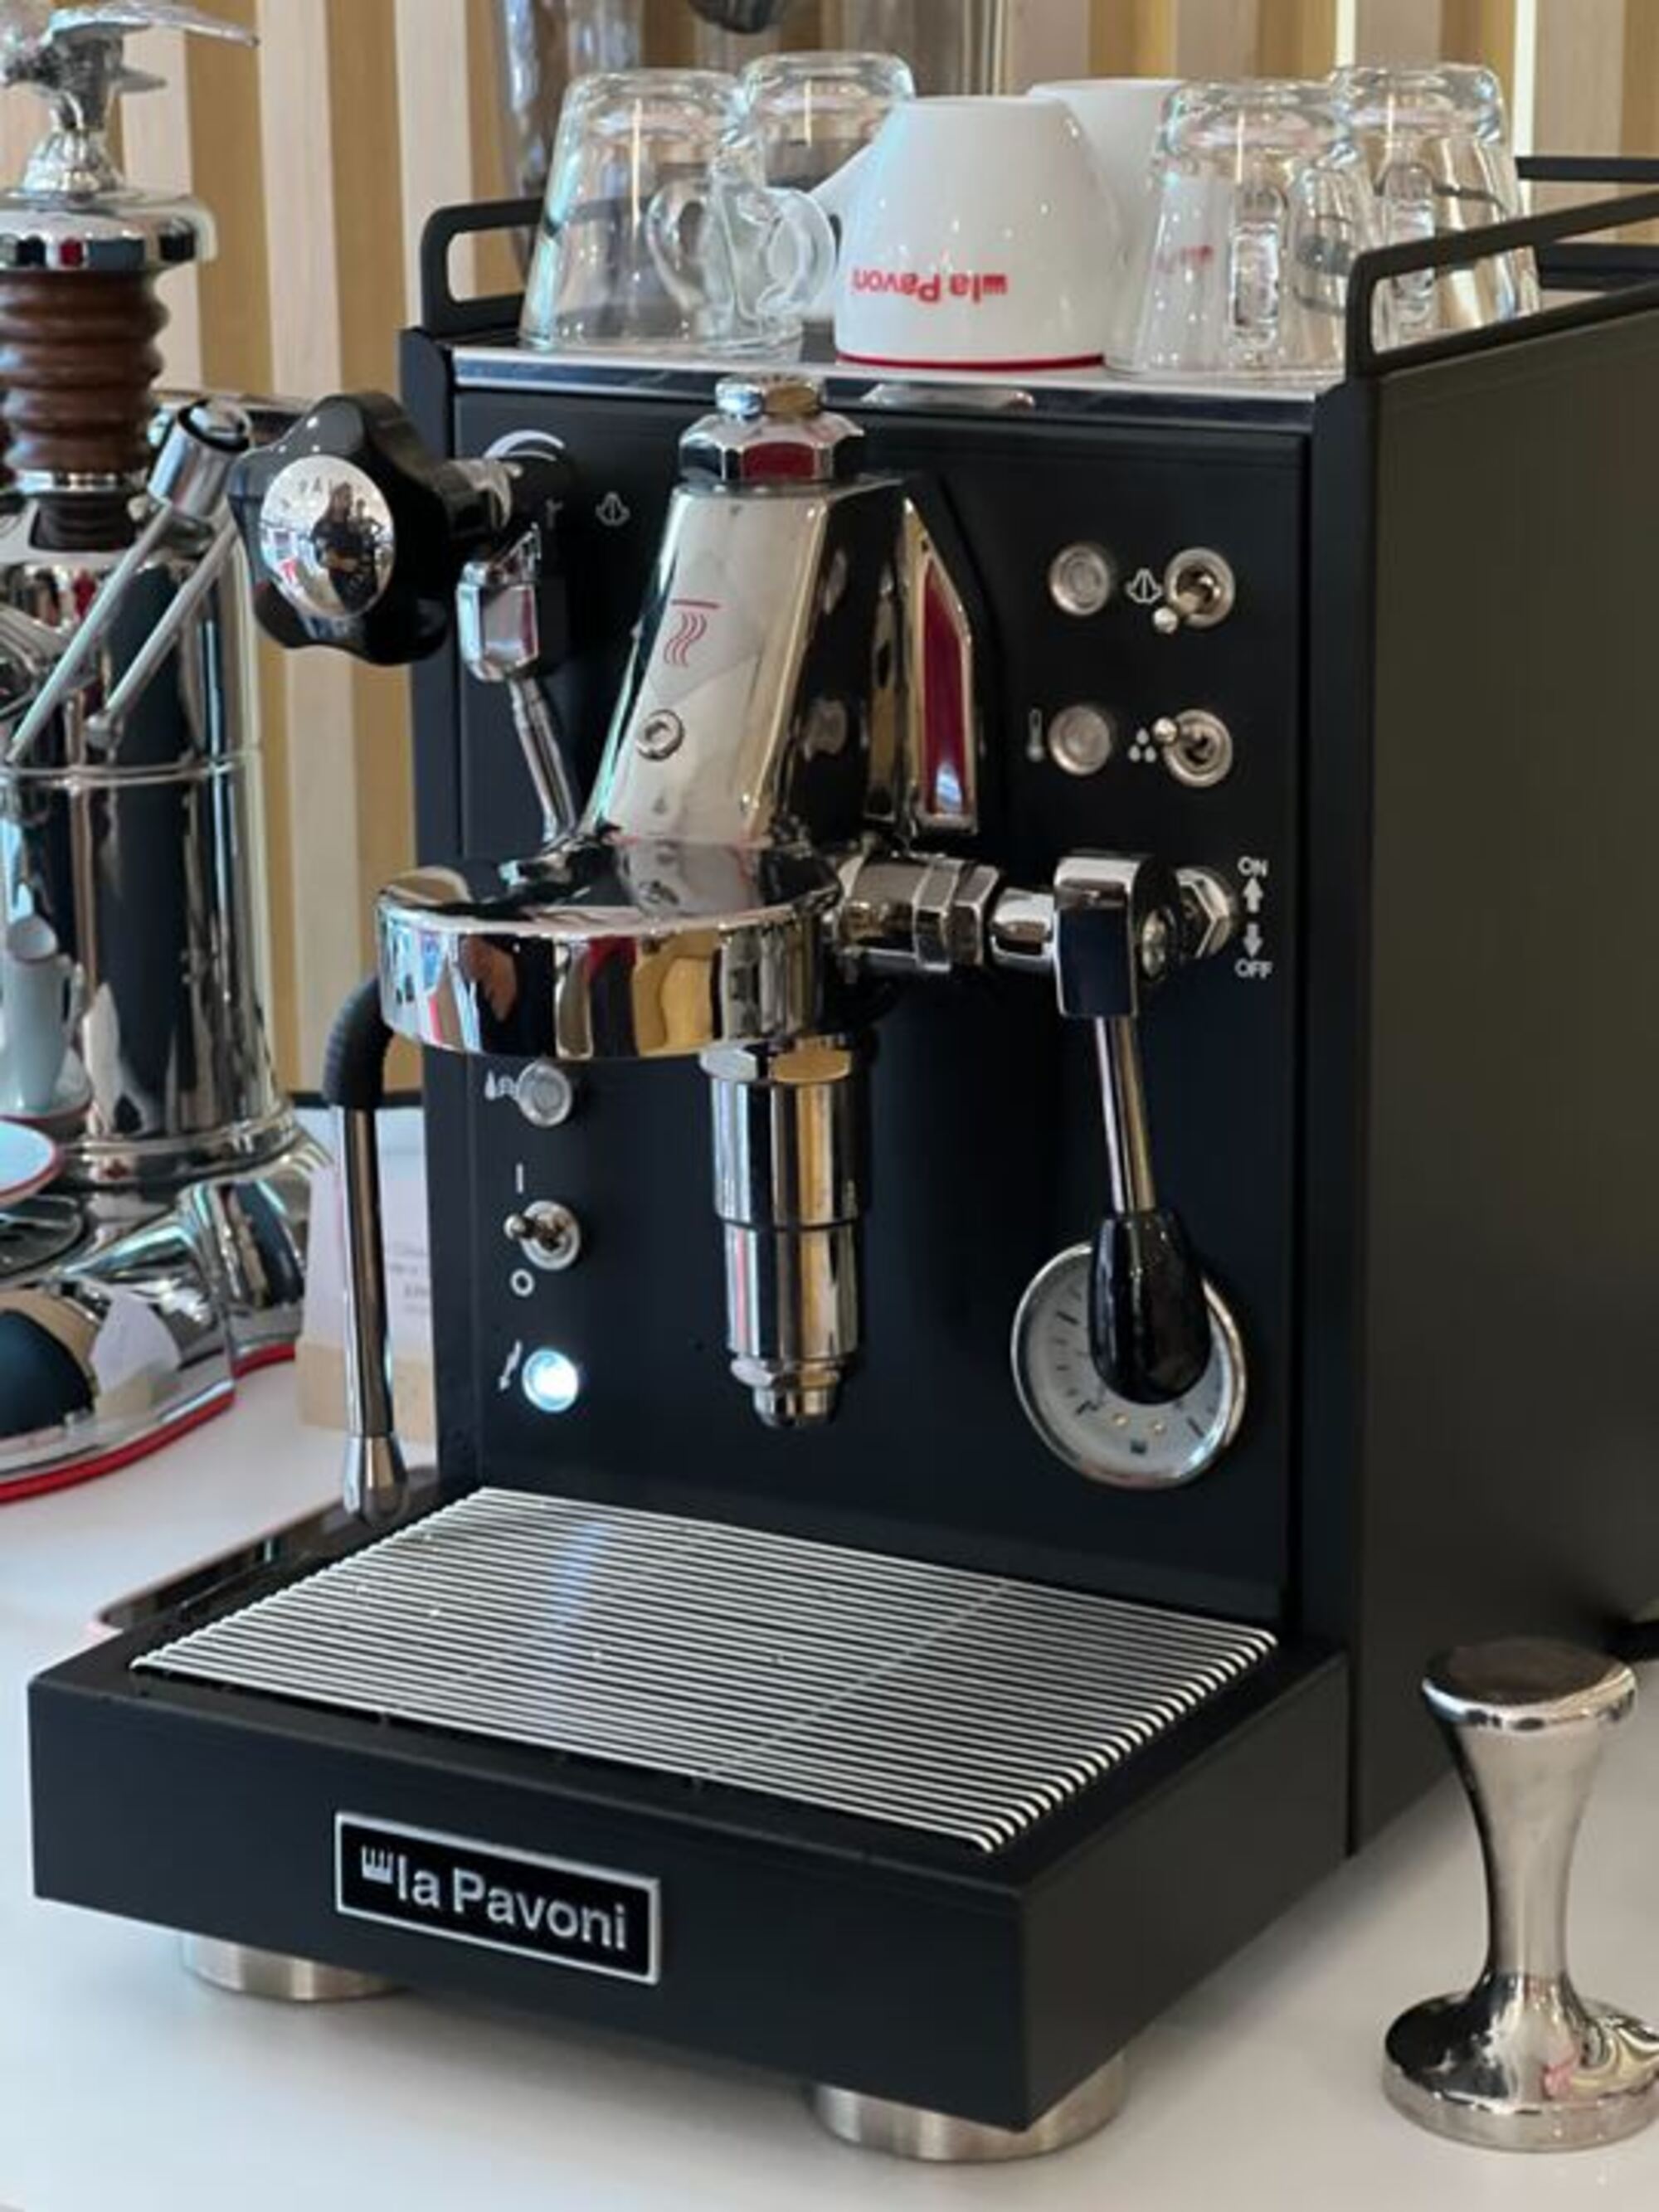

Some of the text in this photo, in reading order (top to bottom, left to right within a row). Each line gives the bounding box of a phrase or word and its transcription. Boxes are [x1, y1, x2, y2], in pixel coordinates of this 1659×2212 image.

[949, 272, 980, 304] la
[1237, 856, 1269, 877] ON
[1234, 957, 1273, 980] OFF
[397, 1854, 627, 1950] la Pavoni
